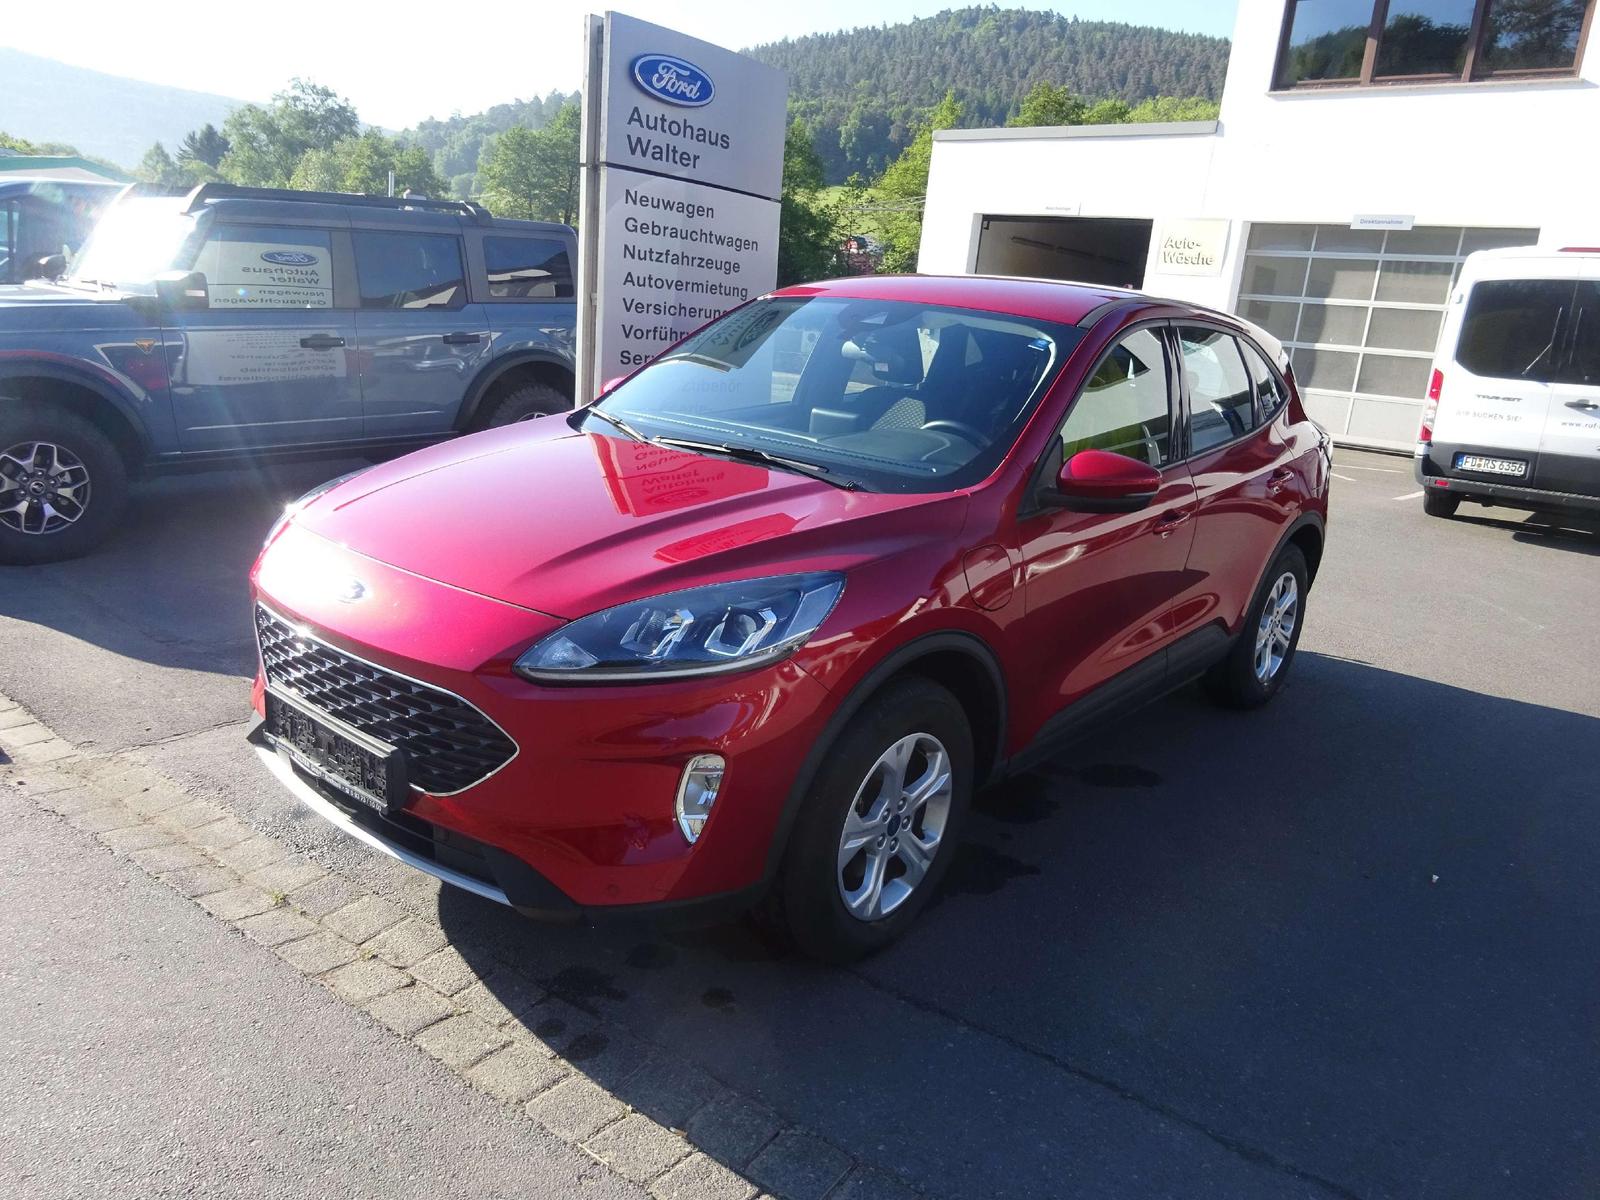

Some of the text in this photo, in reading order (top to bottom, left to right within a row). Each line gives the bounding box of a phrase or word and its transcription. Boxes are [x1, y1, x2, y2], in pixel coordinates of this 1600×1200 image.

[652, 62, 702, 99] Ford
[627, 106, 730, 149] Autohaus
[627, 134, 700, 168] Walter
[625, 189, 714, 218] Neuwagen
[624, 217, 758, 251] Gebrauchtwagen
[623, 244, 741, 274] Nutzfahrzeuge
[1163, 251, 1215, 266] Wäsche
[623, 272, 748, 301] Autovermietung
[622, 324, 689, 342] Vorführ
[620, 350, 654, 365] Ser
[1464, 456, 1523, 473] FD RS 6356
